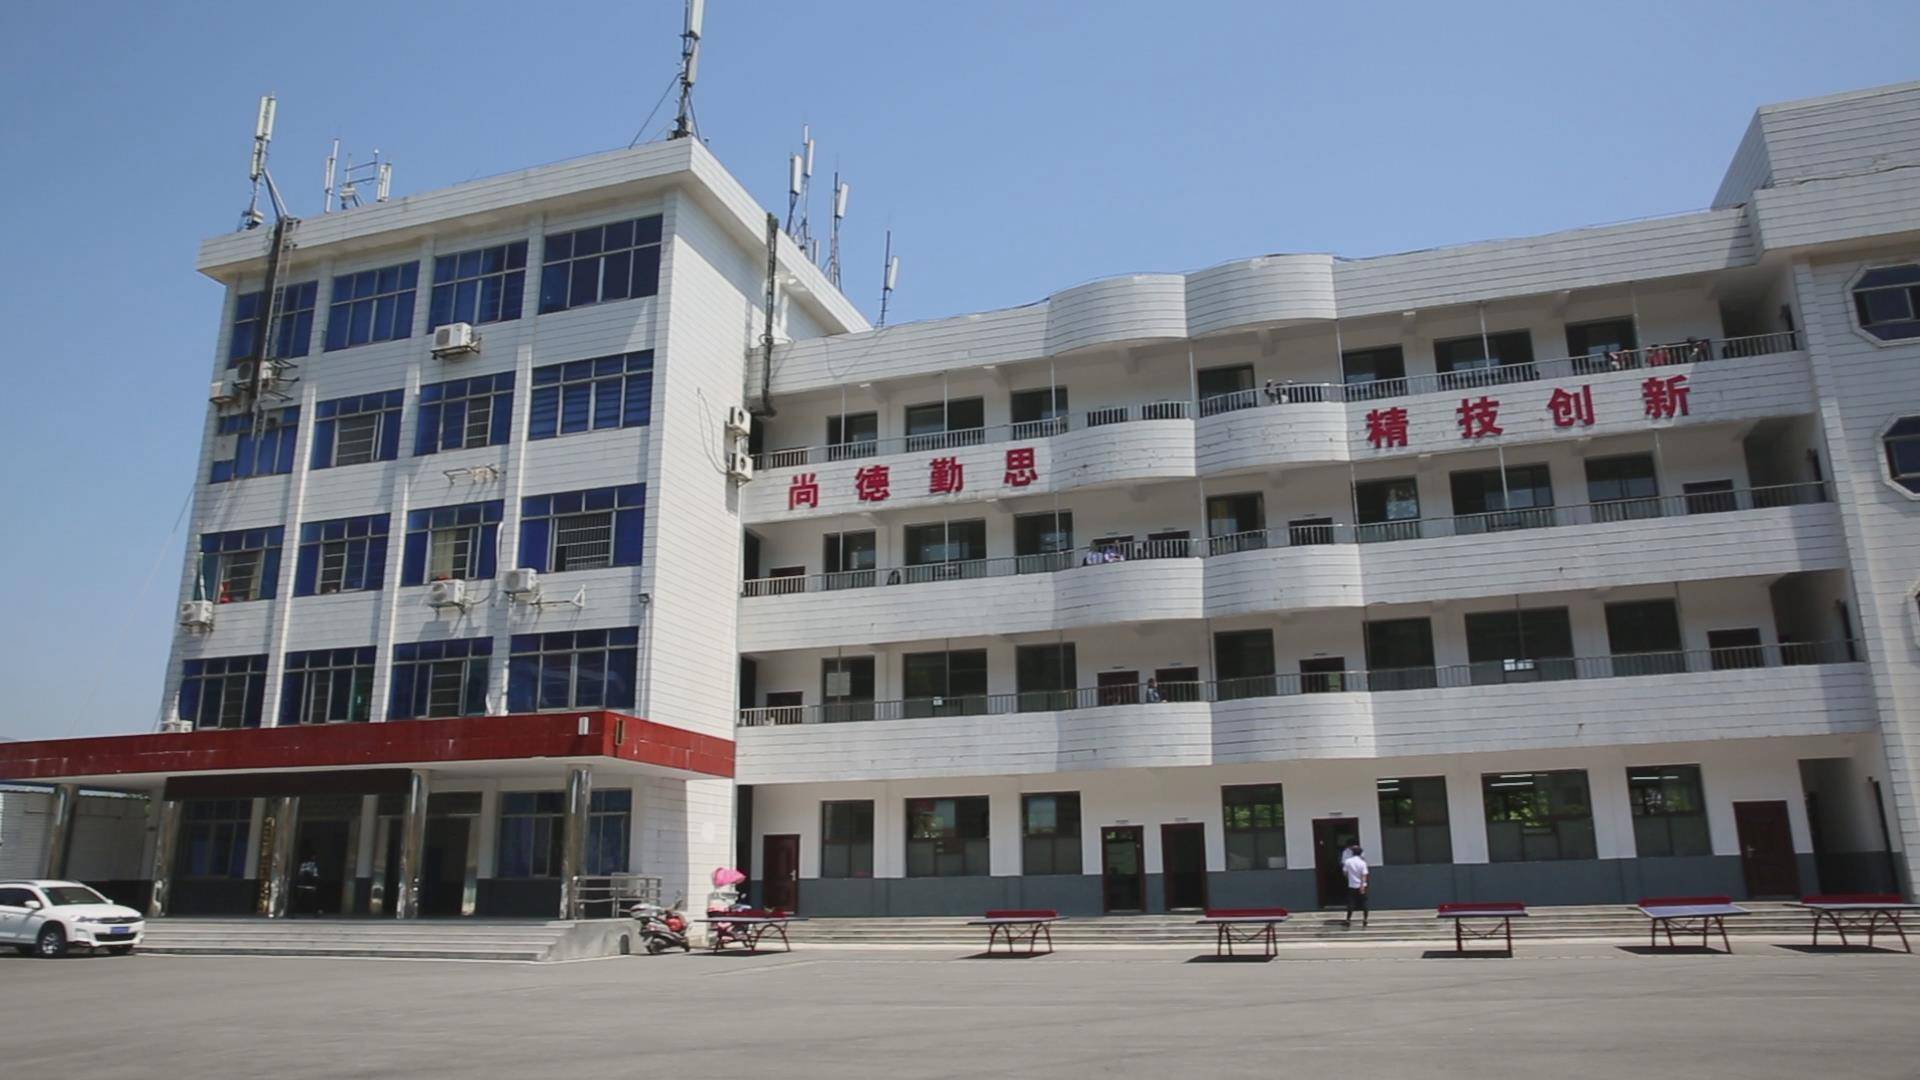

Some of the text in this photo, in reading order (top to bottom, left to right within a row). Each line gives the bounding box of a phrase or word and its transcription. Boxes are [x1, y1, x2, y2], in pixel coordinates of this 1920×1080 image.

[1366, 375, 1690, 448] 精技创新
[789, 448, 1038, 510] 尚德勤思
